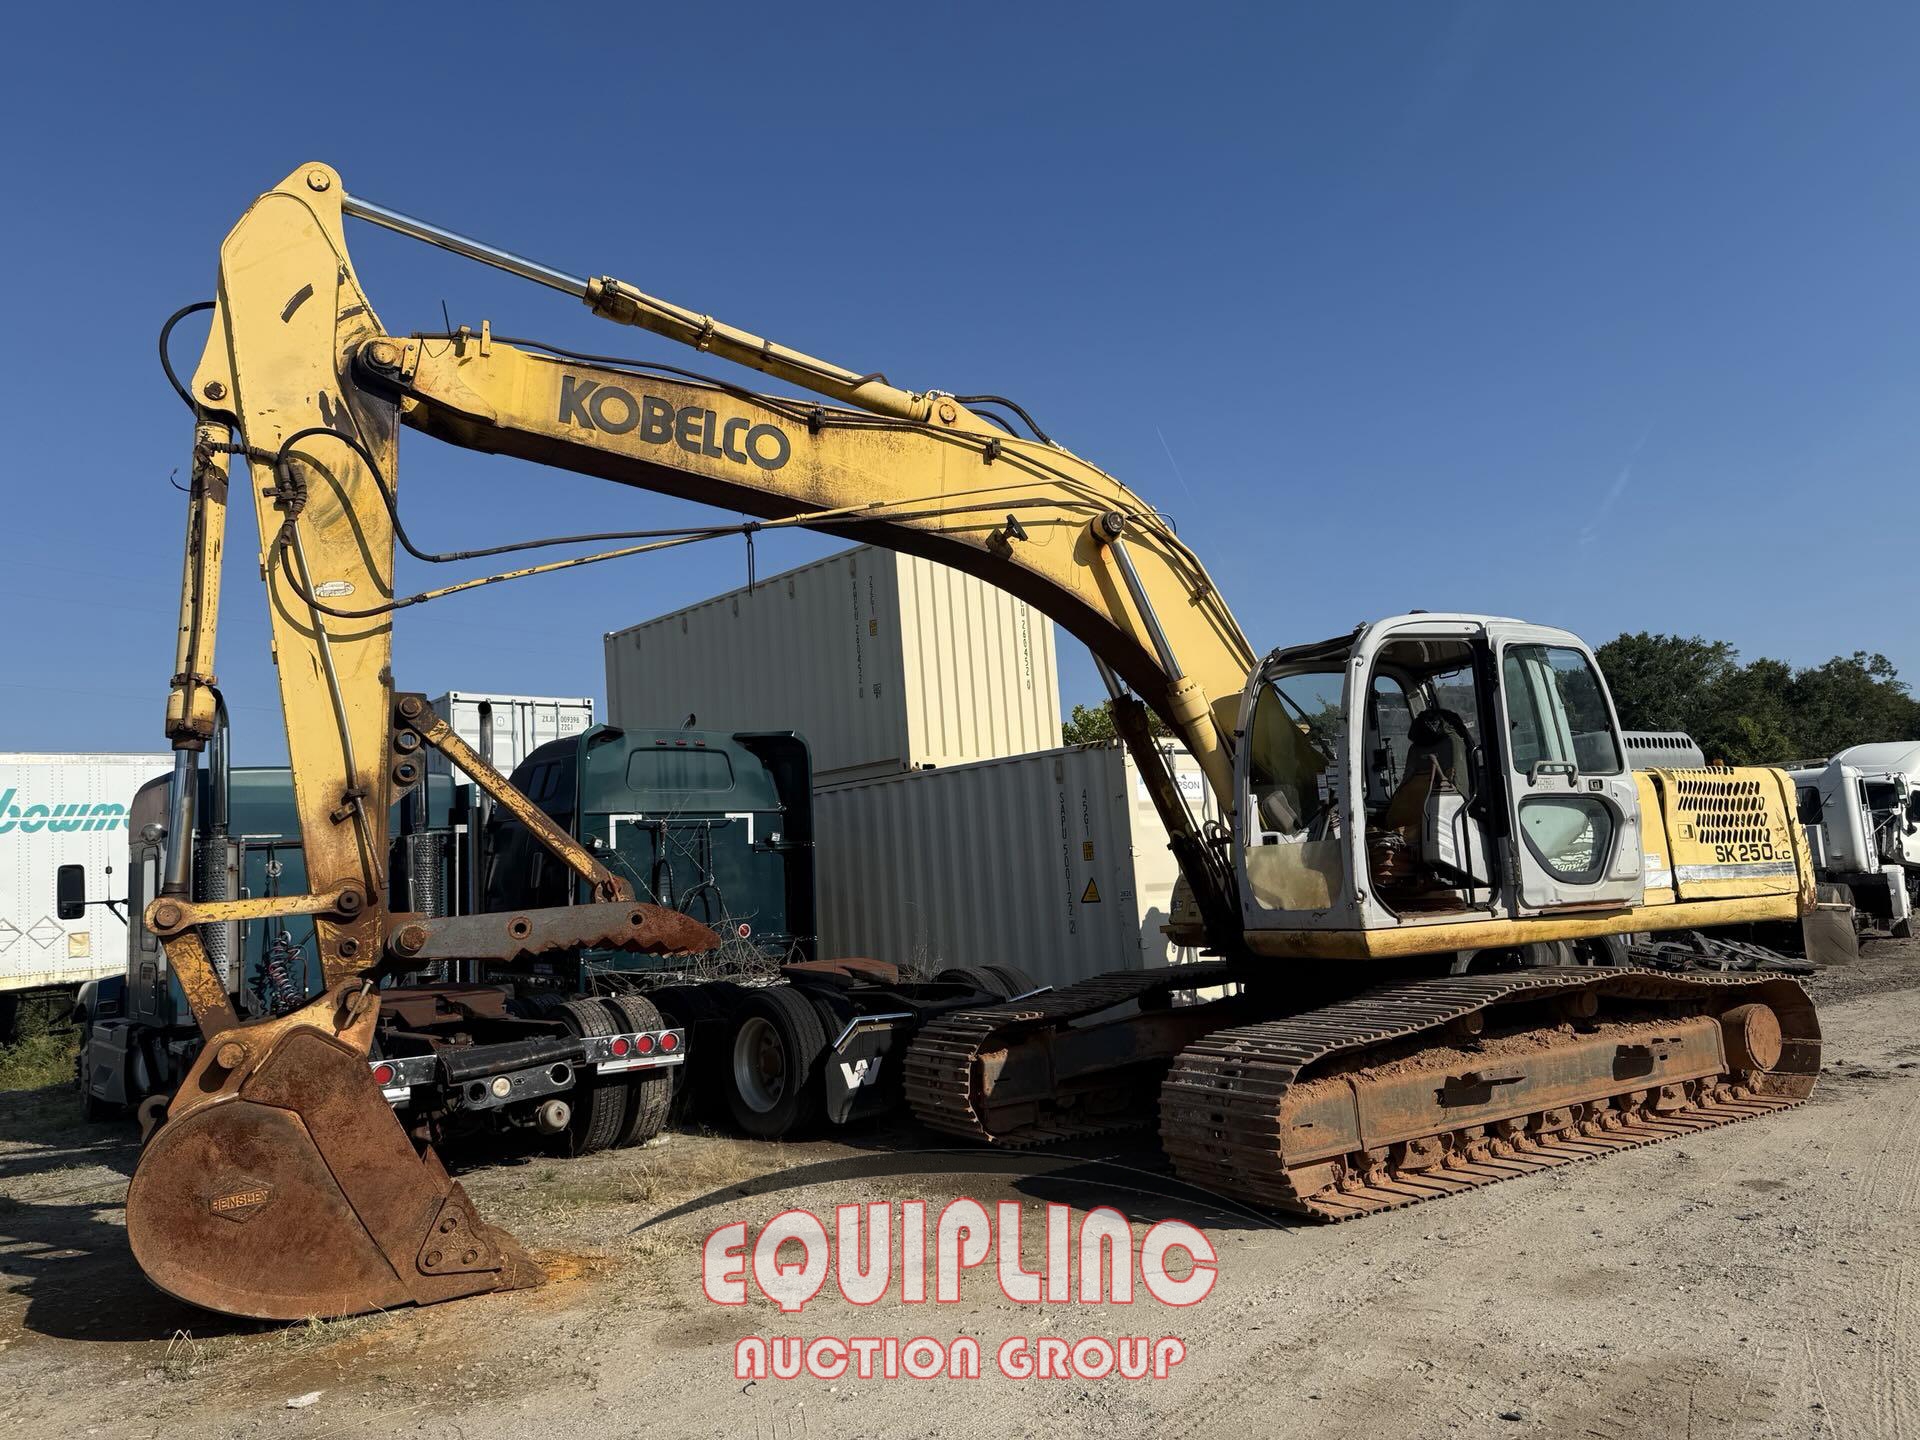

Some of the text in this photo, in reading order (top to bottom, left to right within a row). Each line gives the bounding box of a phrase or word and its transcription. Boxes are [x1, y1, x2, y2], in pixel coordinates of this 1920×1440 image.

[559, 375, 791, 470] KOBELCO
[0, 788, 130, 835] bowm
[1059, 792, 1068, 840] SAPU
[1082, 789, 1090, 837] 45G1
[1063, 844, 1074, 916] 500122
[212, 1189, 272, 1211] HENSLEY
